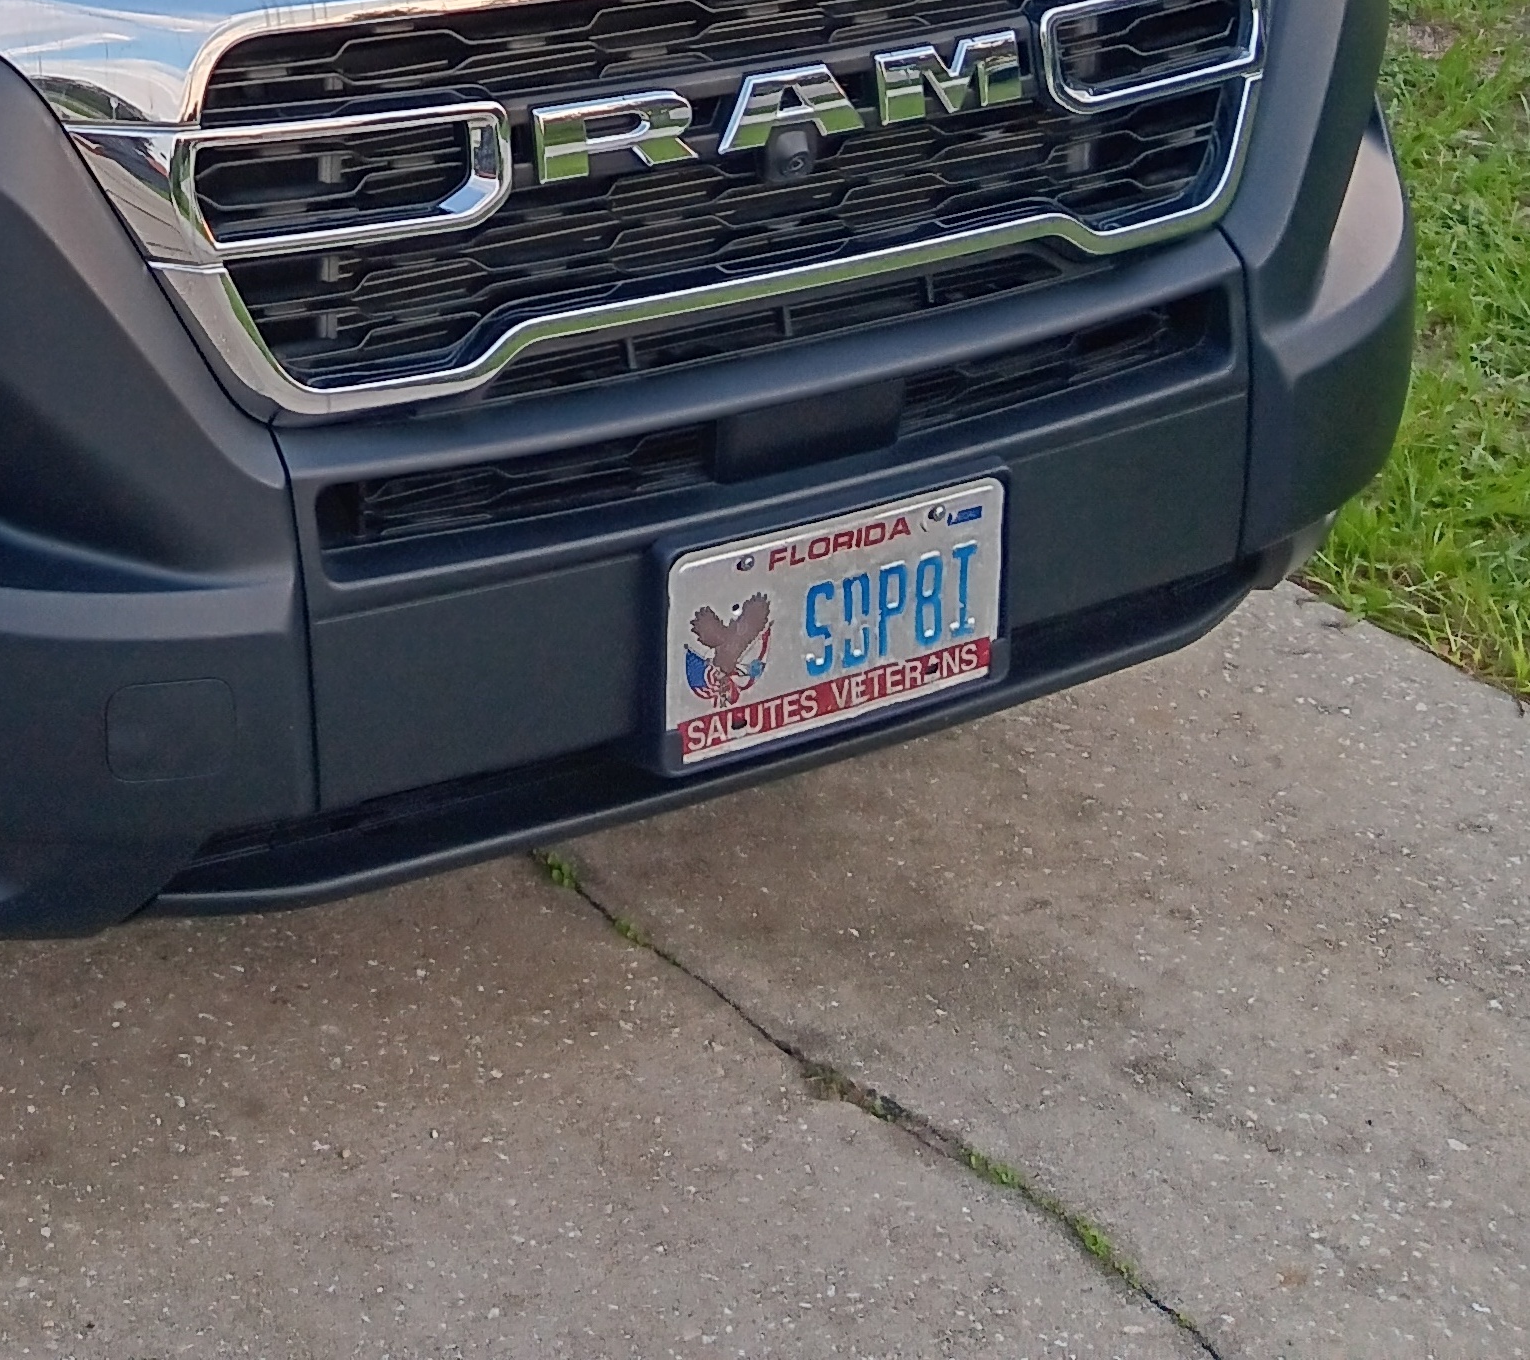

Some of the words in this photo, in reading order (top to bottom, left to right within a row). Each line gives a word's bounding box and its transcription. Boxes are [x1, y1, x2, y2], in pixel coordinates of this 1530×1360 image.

[533, 28, 1023, 186] RAM
[769, 517, 912, 571] FLORIDA
[686, 688, 818, 752] SALUTES
[830, 642, 979, 711] VETERANS
